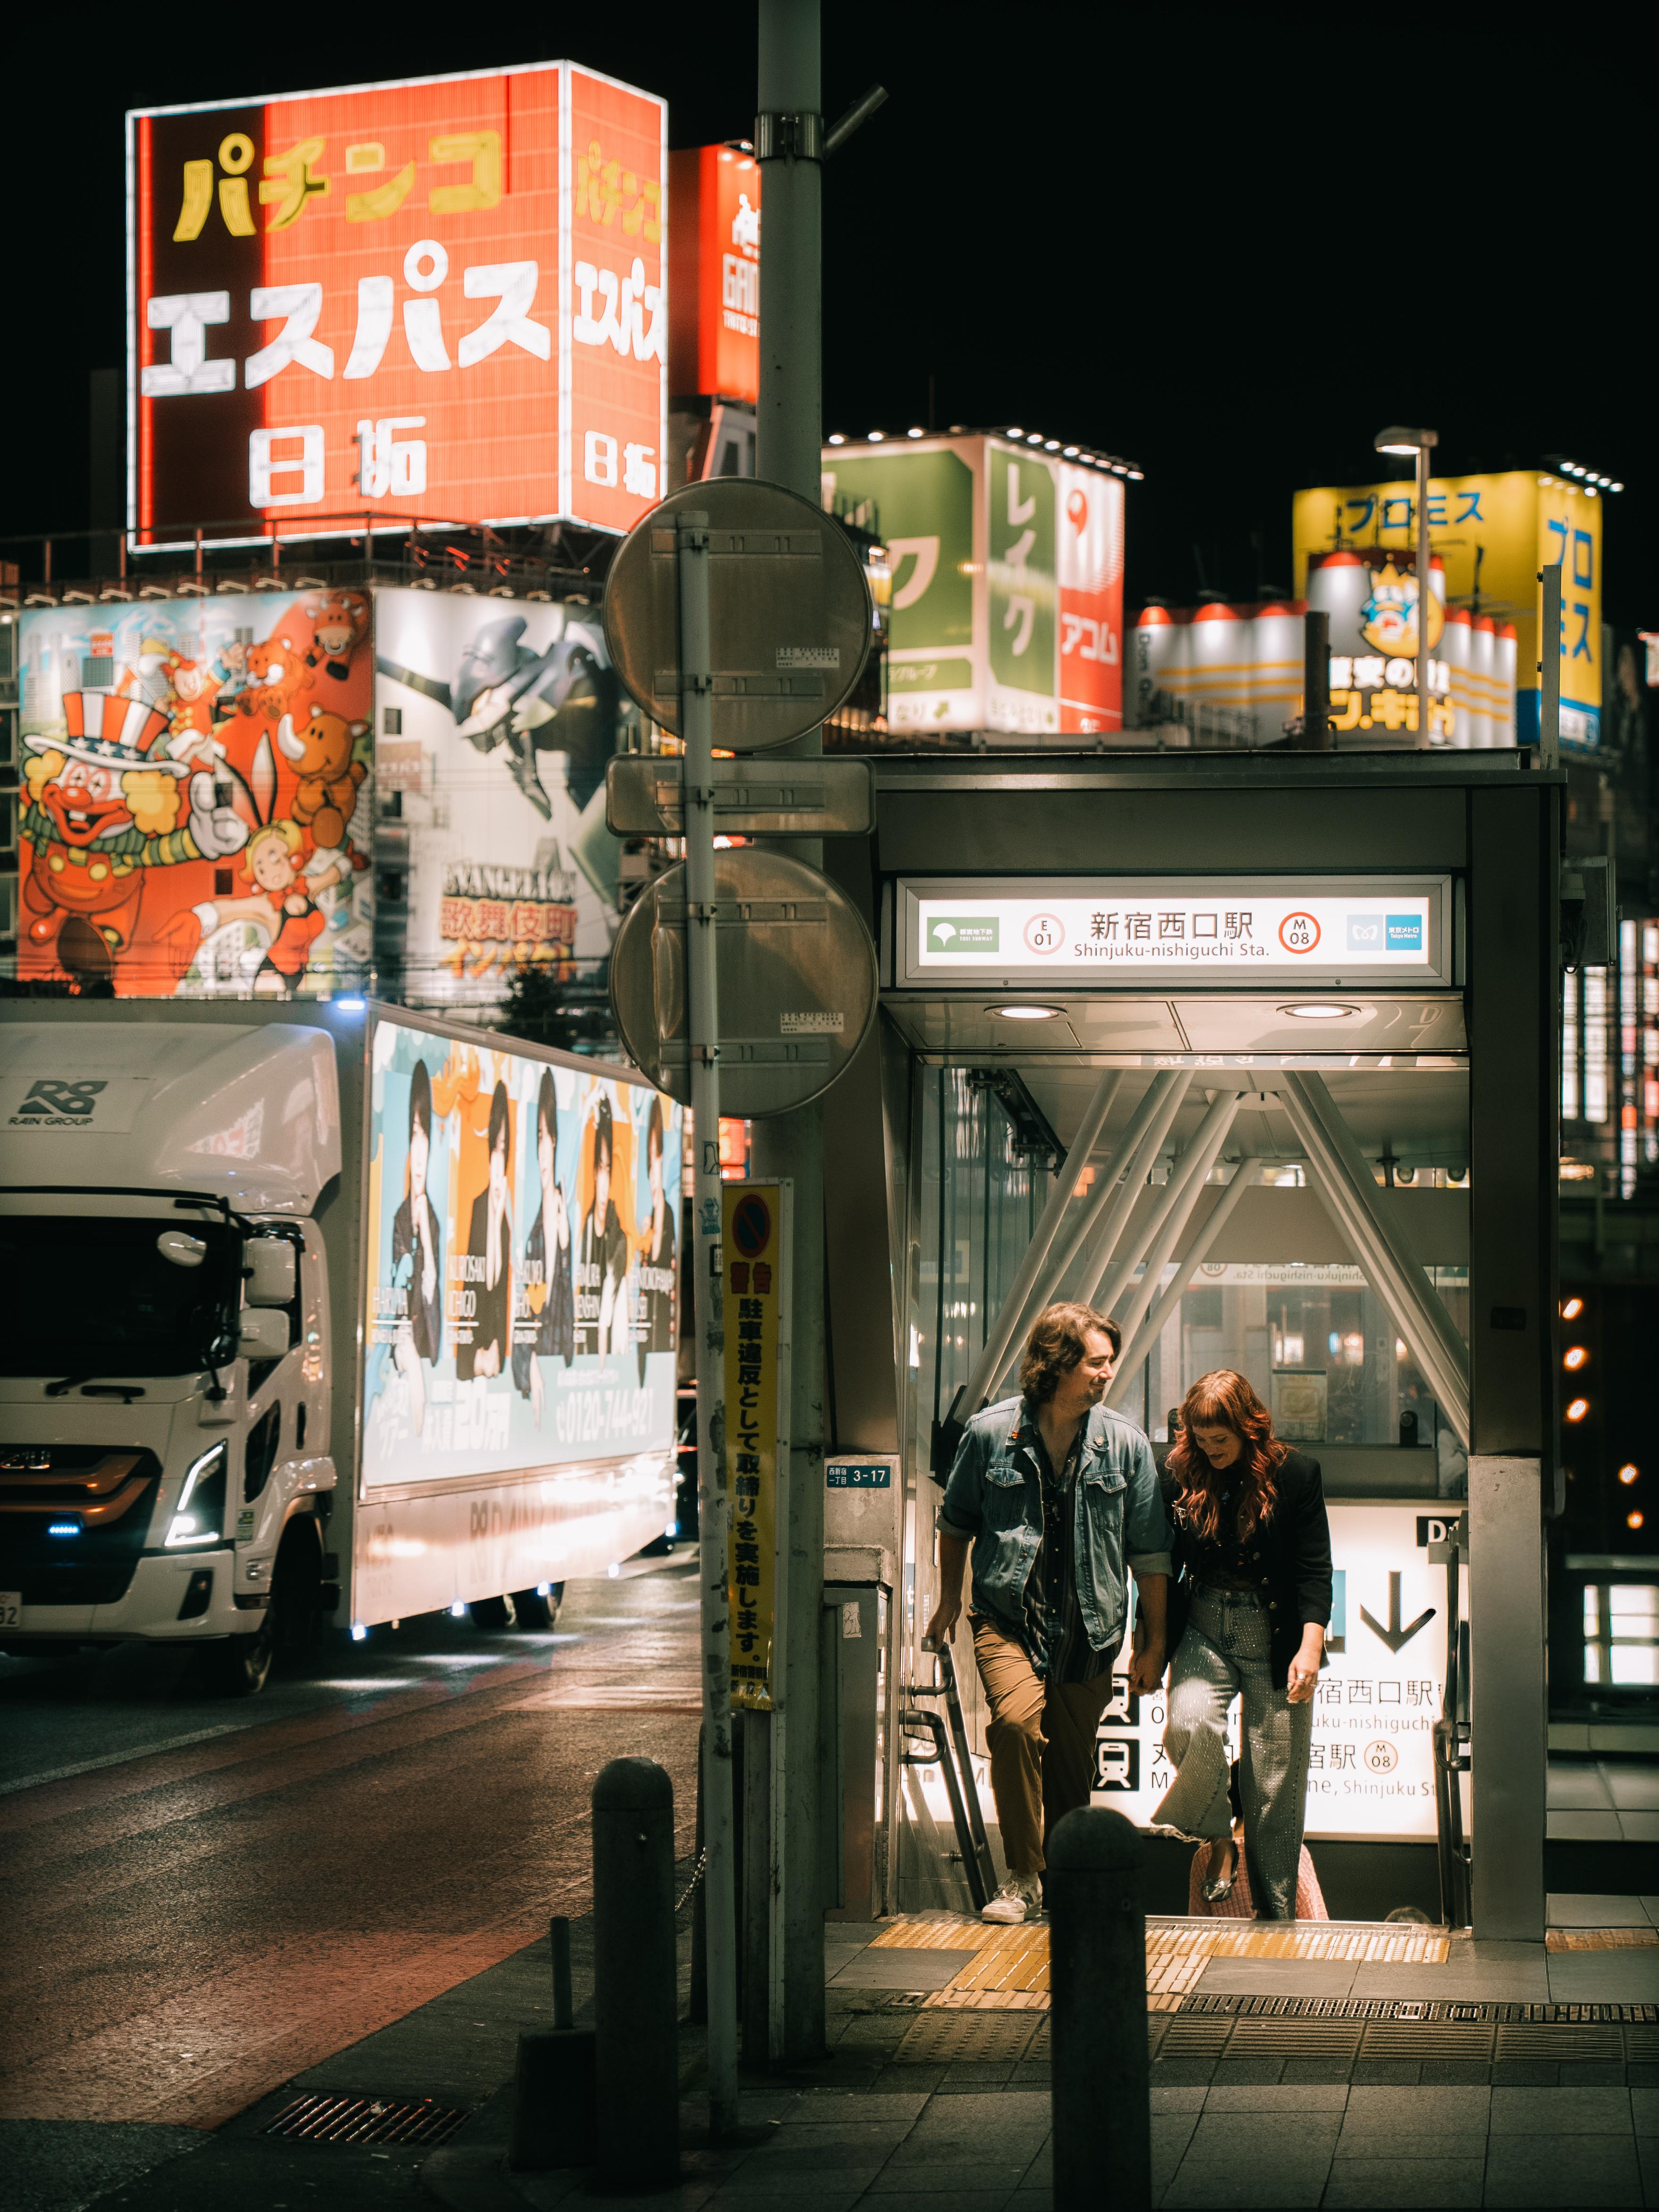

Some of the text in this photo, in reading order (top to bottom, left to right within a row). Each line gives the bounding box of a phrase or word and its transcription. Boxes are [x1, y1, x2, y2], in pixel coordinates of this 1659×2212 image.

[174, 130, 502, 242] パチンコ
[575, 140, 661, 245] パチンコ
[141, 239, 551, 398] エスパス
[573, 257, 661, 362] エスパス
[249, 416, 427, 508] 日拓
[1346, 491, 1484, 532] プロミス
[1005, 463, 1036, 656] レイク
[1061, 613, 1119, 666] アコム
[440, 896, 579, 943] 歌舞伎町
[1041, 920, 1048, 931] E
[1090, 911, 1253, 940] 新宿西口駅
[1293, 919, 1306, 930] M
[1034, 933, 1052, 946] 01
[1289, 932, 1309, 945] 08
[1074, 943, 1269, 960] Shinjuku-nishiguchi Sta.
[8, 1117, 93, 1125] RAIN GROUP
[735, 1298, 763, 1663] 駐車違反として取締りを実施します。
[829, 1467, 885, 1482] 西新宿 3-17
[829, 1477, 847, 1485] 一丁目
[1376, 1744, 1386, 1753] M
[1371, 1755, 1391, 1768] 08
[1343, 1780, 1416, 1798] Shinjuku
